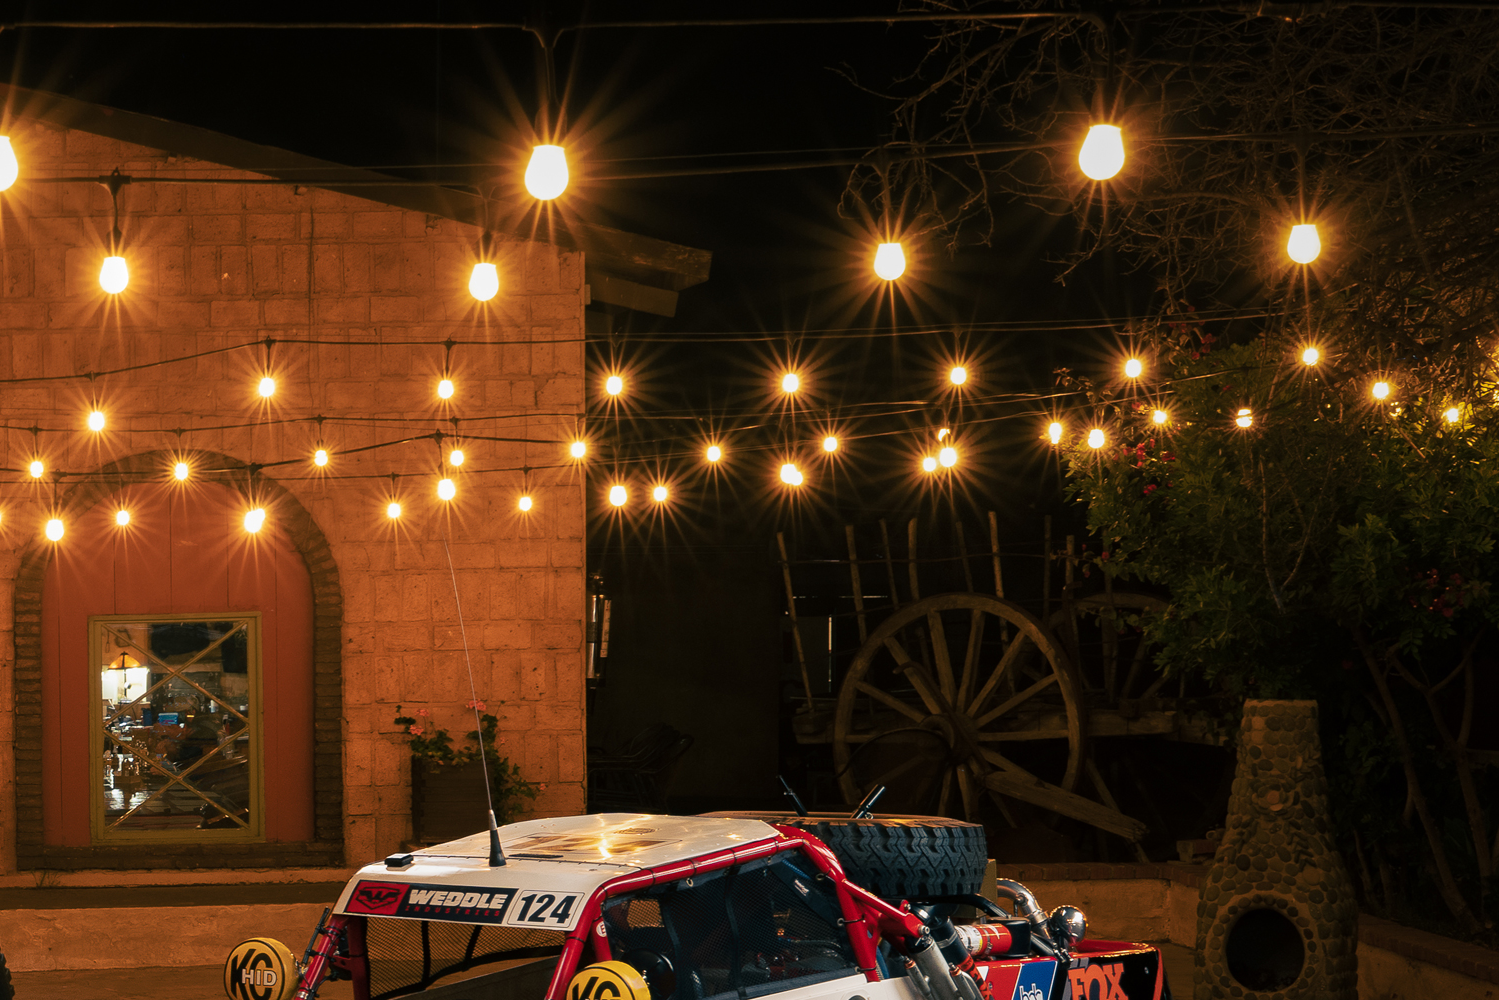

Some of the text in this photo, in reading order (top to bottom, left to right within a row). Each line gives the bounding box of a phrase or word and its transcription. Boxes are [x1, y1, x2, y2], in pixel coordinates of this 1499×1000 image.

[407, 889, 508, 910] WEDDLE
[515, 893, 578, 924] 124
[404, 905, 501, 917] INDUSTRIES
[241, 968, 277, 987] HID
